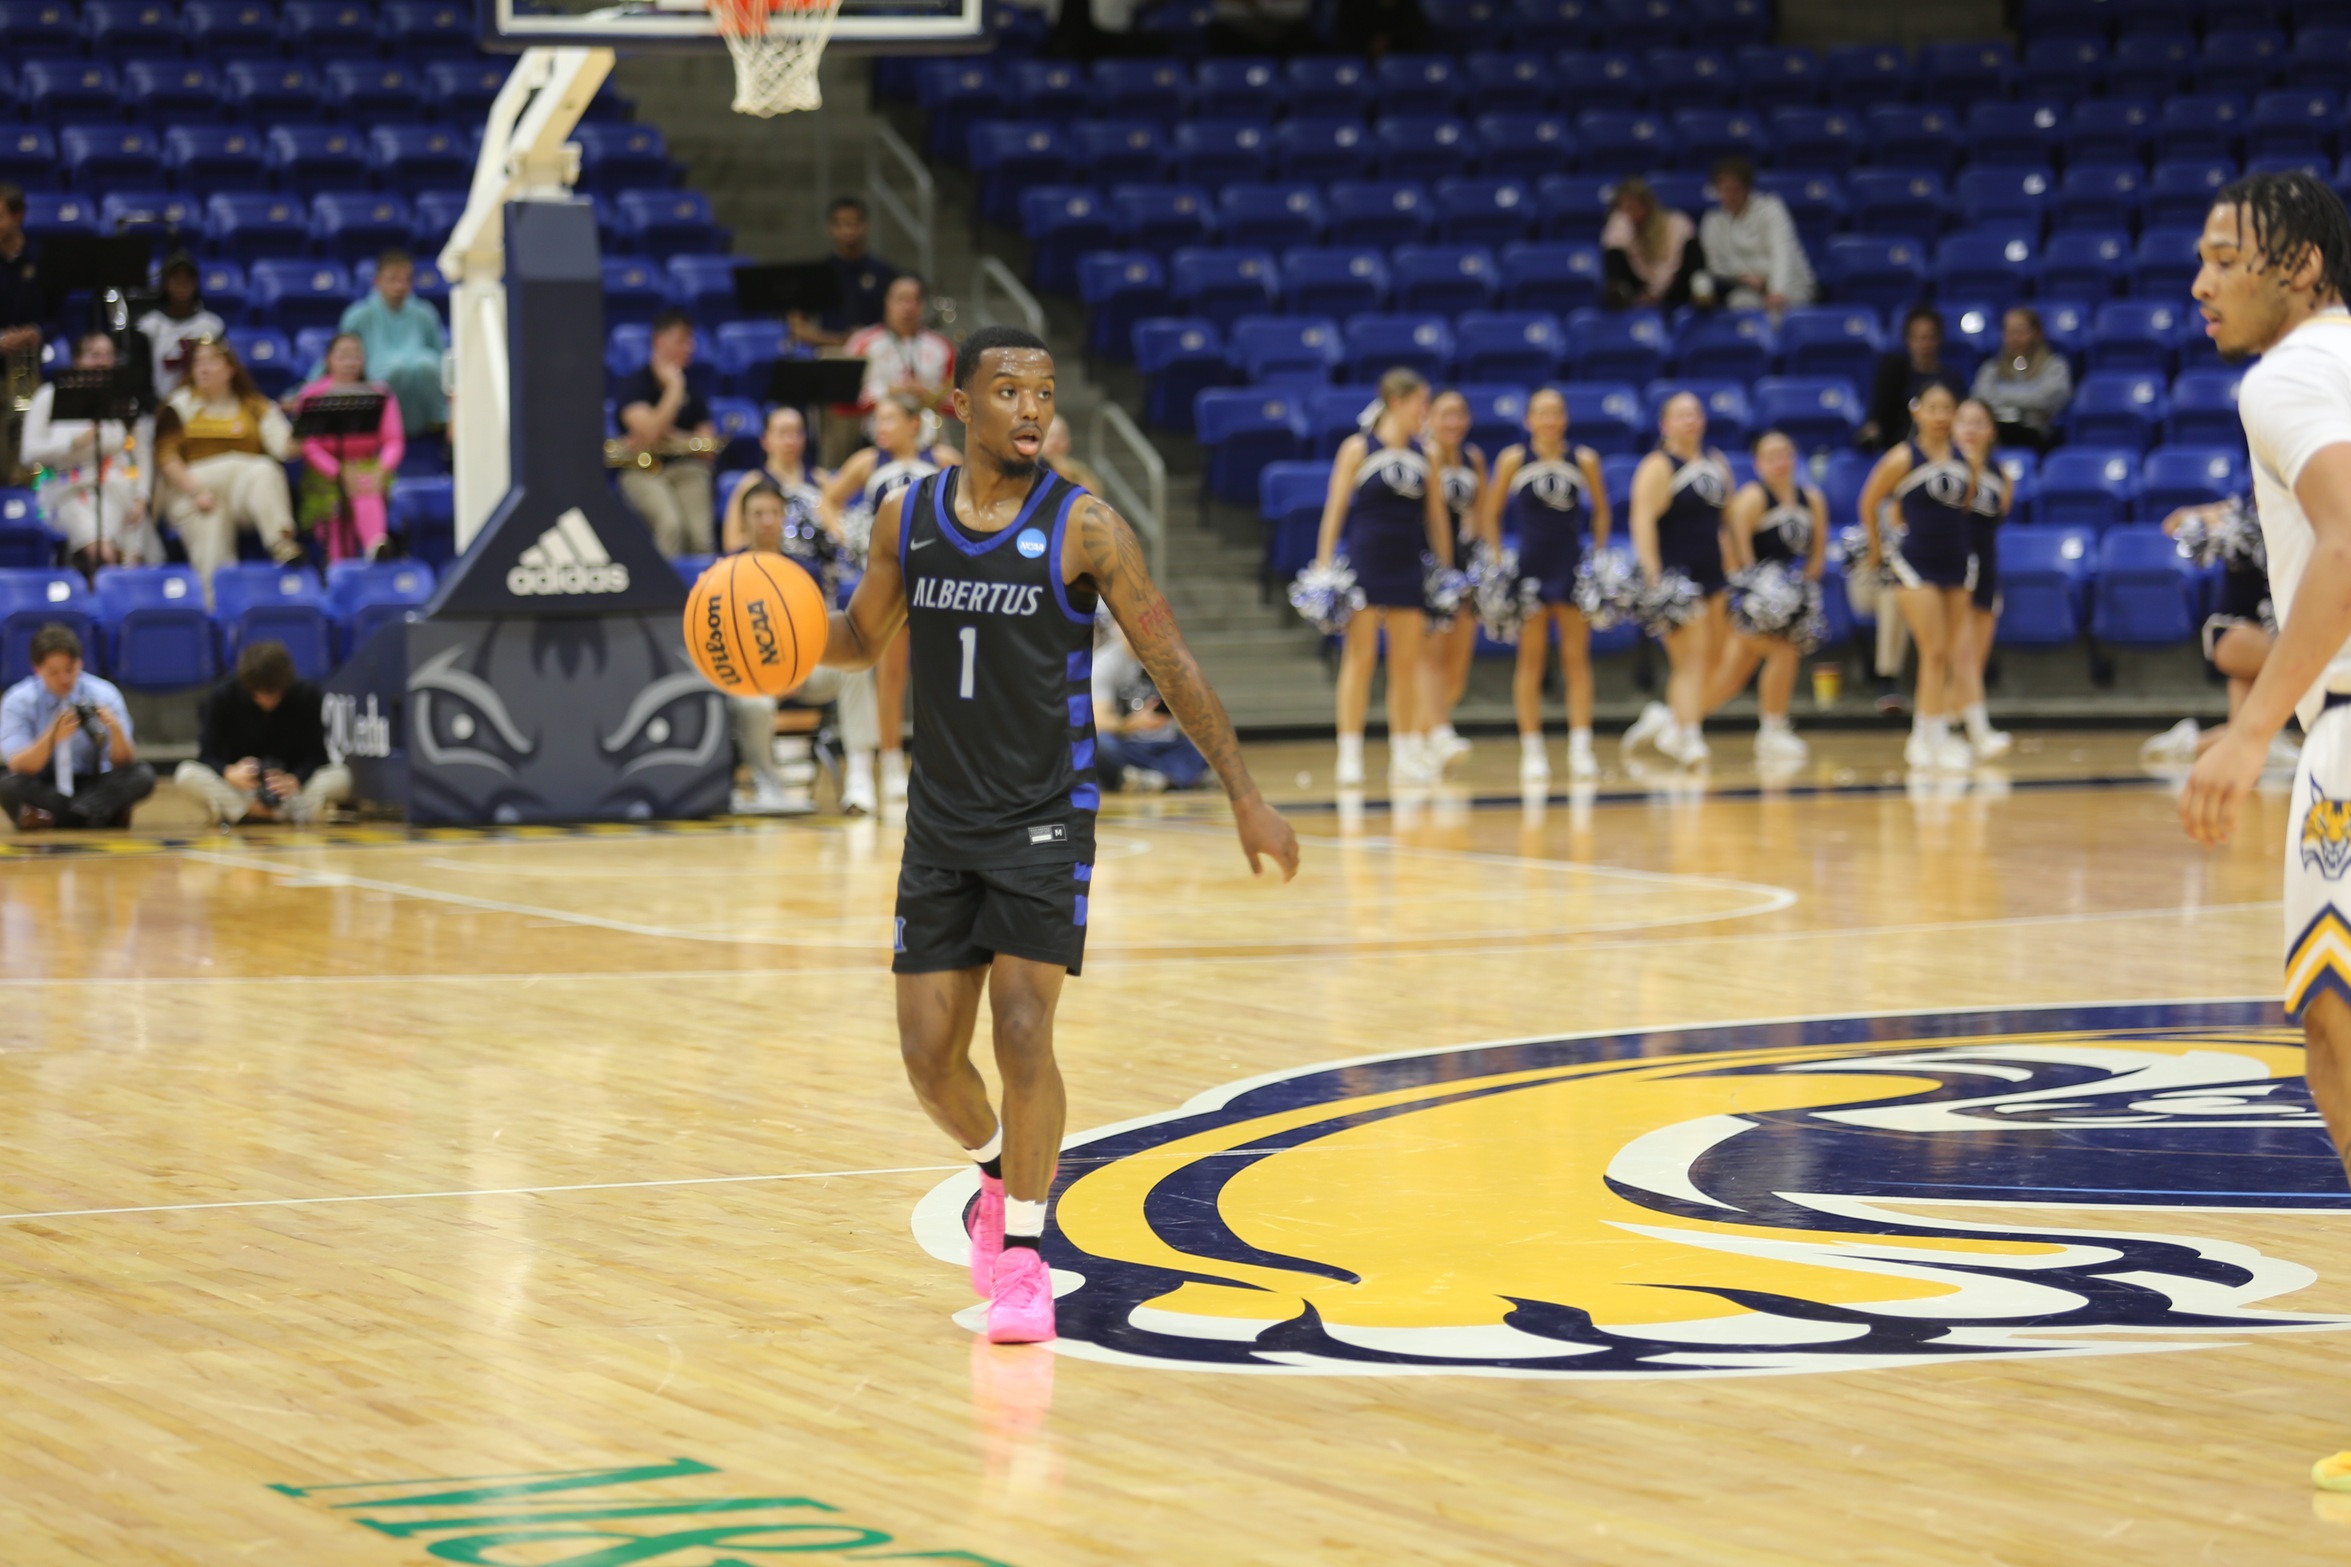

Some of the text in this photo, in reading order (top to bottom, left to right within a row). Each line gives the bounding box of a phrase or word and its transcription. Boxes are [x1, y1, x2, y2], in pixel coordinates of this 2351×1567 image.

[1020, 541, 1045, 553] NCAA
[506, 561, 630, 596] adidas
[912, 576, 1043, 616] ALBERTUS
[705, 594, 742, 686] Wilson
[746, 599, 781, 666] NCAA
[959, 626, 977, 699] 1
[1054, 828, 1063, 837] M
